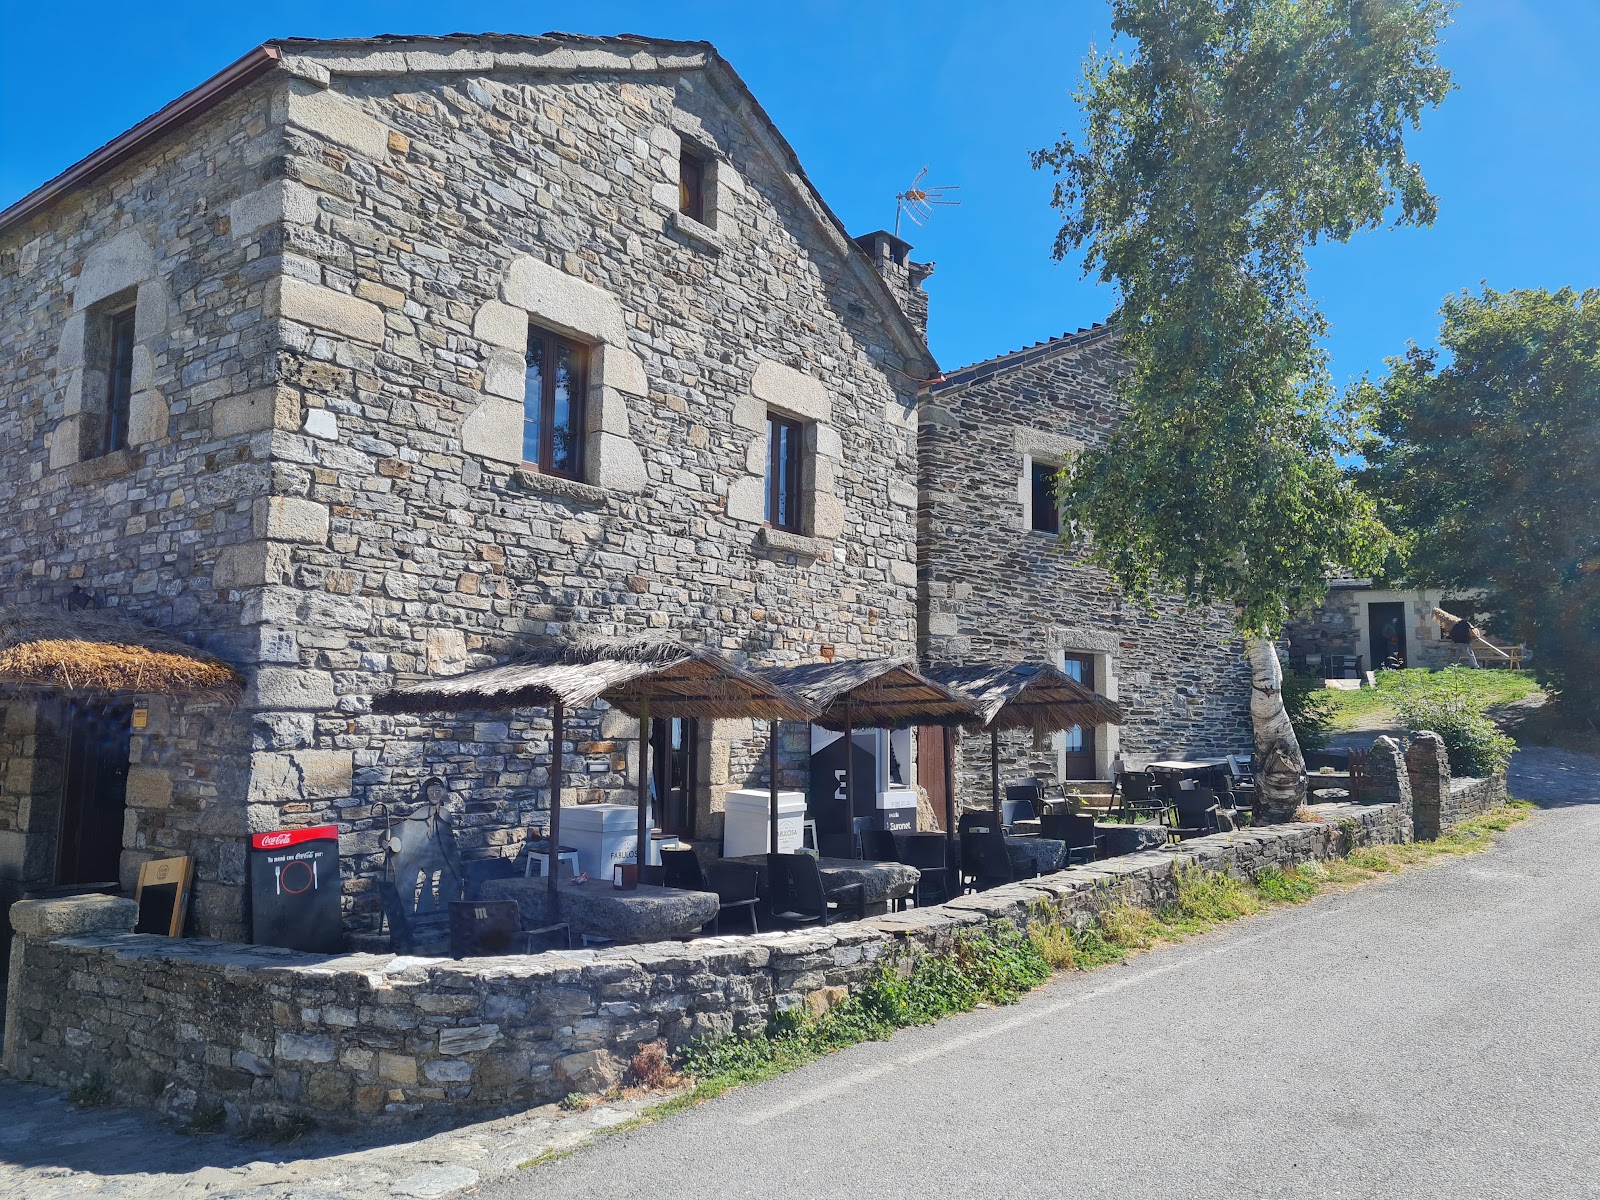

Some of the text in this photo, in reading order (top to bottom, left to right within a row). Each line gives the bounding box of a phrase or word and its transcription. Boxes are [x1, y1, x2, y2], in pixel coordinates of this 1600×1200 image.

[890, 821, 912, 831] Euronet
[262, 833, 291, 846] Coca-Cola
[611, 850, 638, 859] FABULOS
